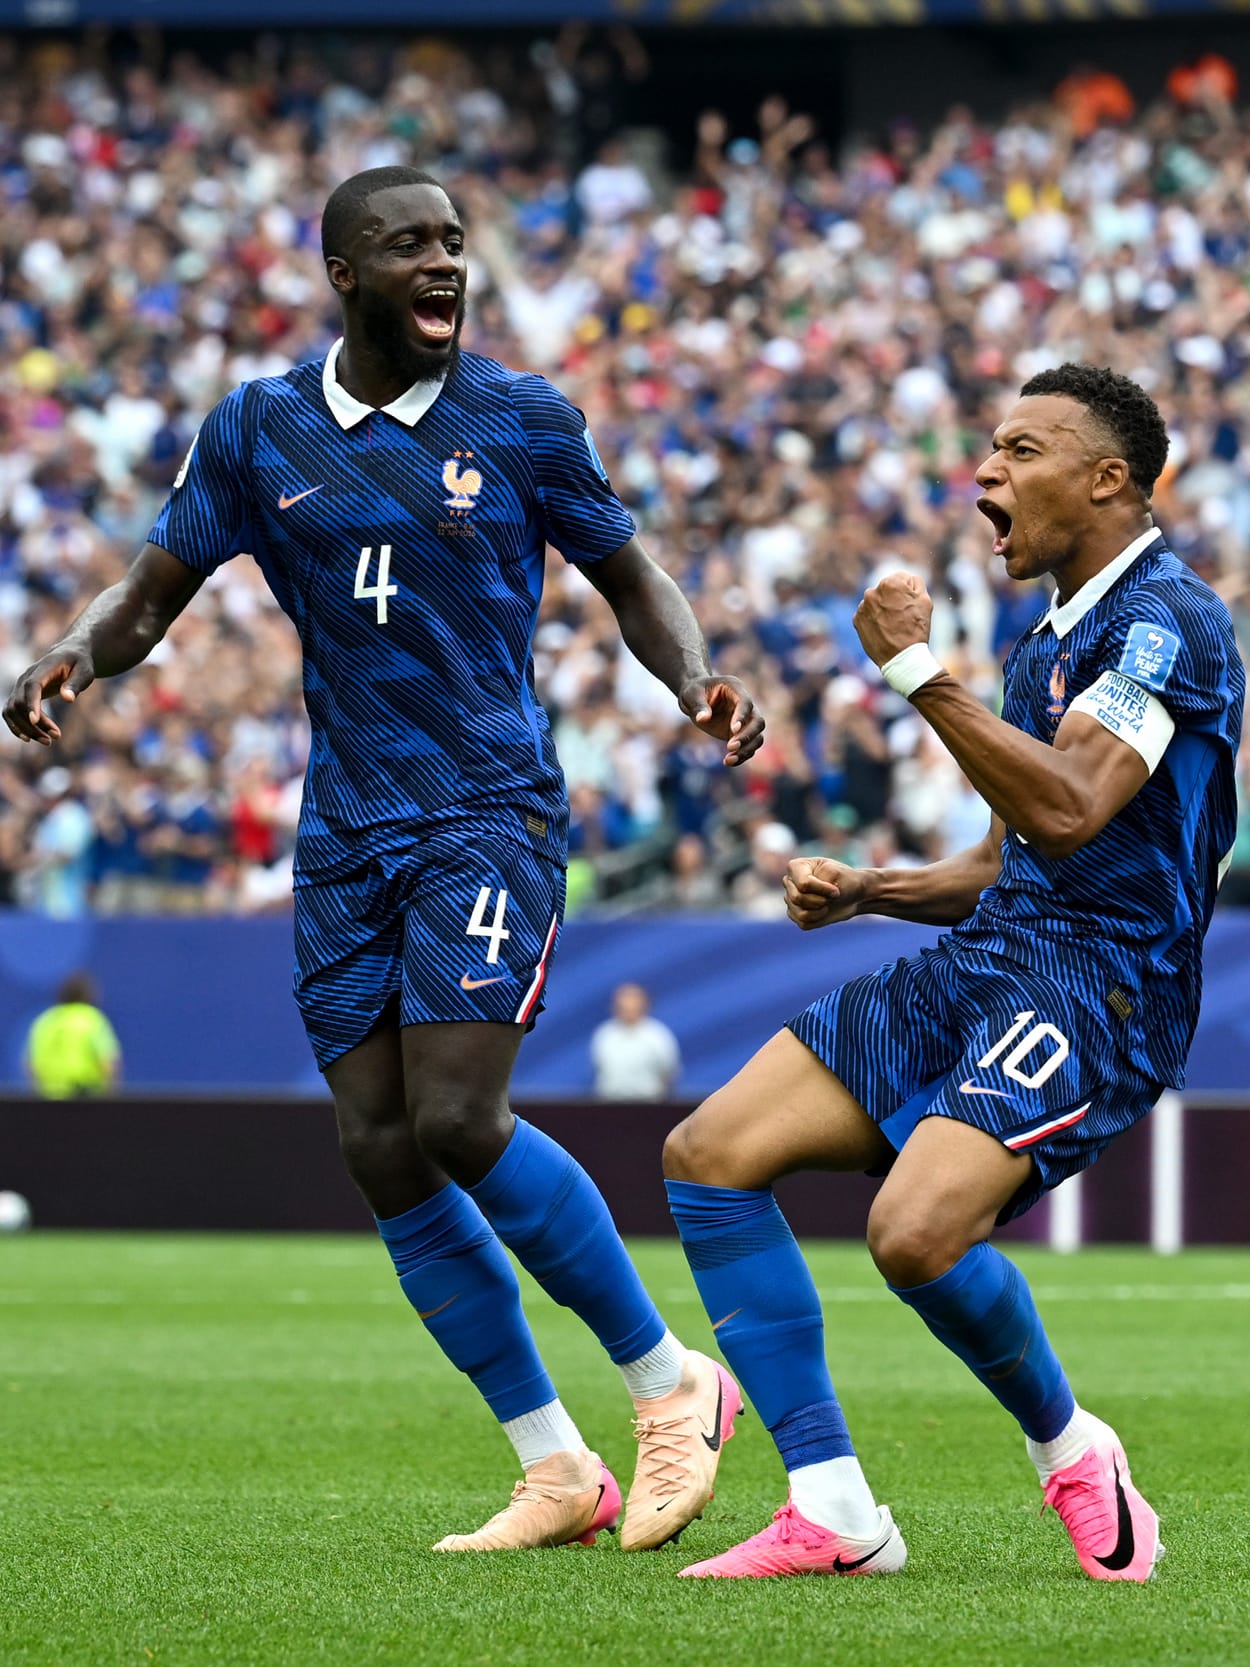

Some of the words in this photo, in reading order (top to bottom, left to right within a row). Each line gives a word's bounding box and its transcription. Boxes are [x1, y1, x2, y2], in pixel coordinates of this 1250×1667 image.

[354, 544, 398, 625] 4
[1106, 673, 1149, 708] FOOTBALL
[1134, 656, 1160, 676] PEACE
[1096, 683, 1146, 720] UNITES
[466, 886, 510, 965] 4
[977, 1011, 1070, 1089] 10
